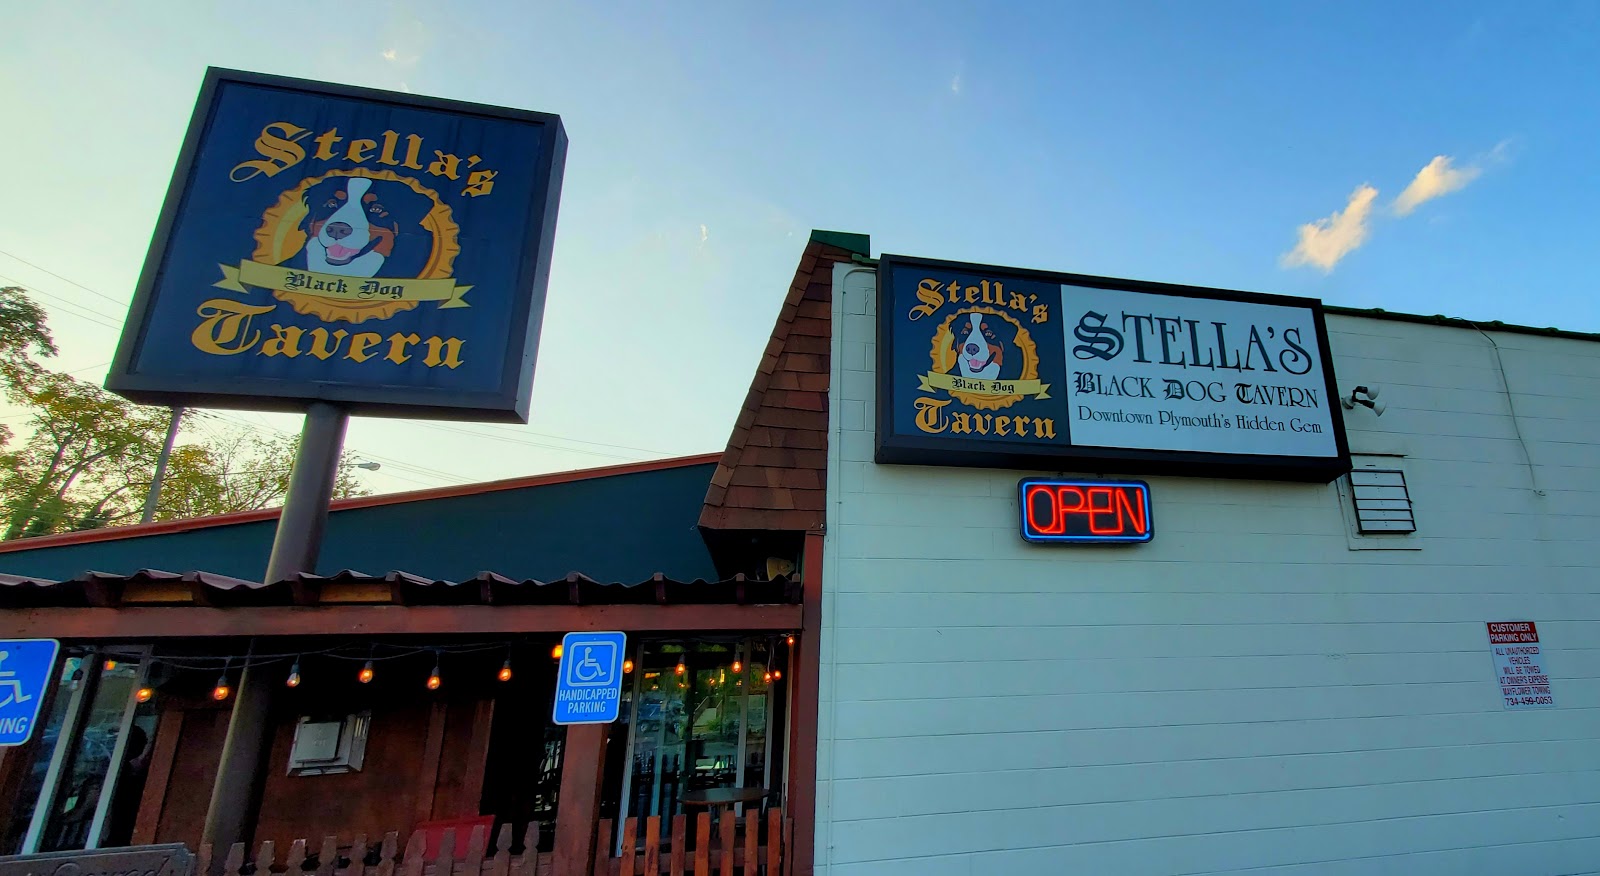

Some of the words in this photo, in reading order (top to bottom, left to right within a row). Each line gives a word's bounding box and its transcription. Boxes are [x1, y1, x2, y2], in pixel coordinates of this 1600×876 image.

[229, 121, 499, 198] Stella's
[284, 271, 349, 294] Black
[359, 279, 405, 300] Dog
[908, 278, 1049, 325] Stella's
[191, 298, 467, 370] Tavern
[1072, 310, 1313, 375] STELLA'S
[950, 377, 987, 393] Black
[989, 380, 1016, 395] Dog
[1072, 371, 1156, 398] BLACK
[1162, 377, 1227, 403] DOG
[1233, 382, 1319, 409] TAVERN
[913, 396, 1057, 440] Tavern
[1078, 405, 1154, 425] Downtown
[1158, 410, 1231, 431] Plymouth's
[1235, 414, 1286, 432] Hidden
[1290, 418, 1323, 434] Gem
[1025, 485, 1148, 534] OPEN
[1490, 623, 1531, 632] CUSTOMER
[1490, 633, 1519, 642] PARKING
[1519, 632, 1538, 642] ONLY
[1495, 647, 1505, 656] ALL
[1505, 646, 1540, 655] UNAUTHORIZED
[1508, 656, 1531, 665] VEHICLES
[1503, 666, 1515, 675] WILL
[1515, 666, 1523, 674] BE
[1523, 665, 1541, 674] TOWED
[1528, 675, 1550, 684] EXPENSE
[558, 687, 618, 702] HANDICAPPED
[1503, 687, 1532, 696] MAYFLOWER
[1532, 686, 1551, 695] TOWING
[567, 701, 607, 714] PARKING
[0, 717, 28, 734] ING
